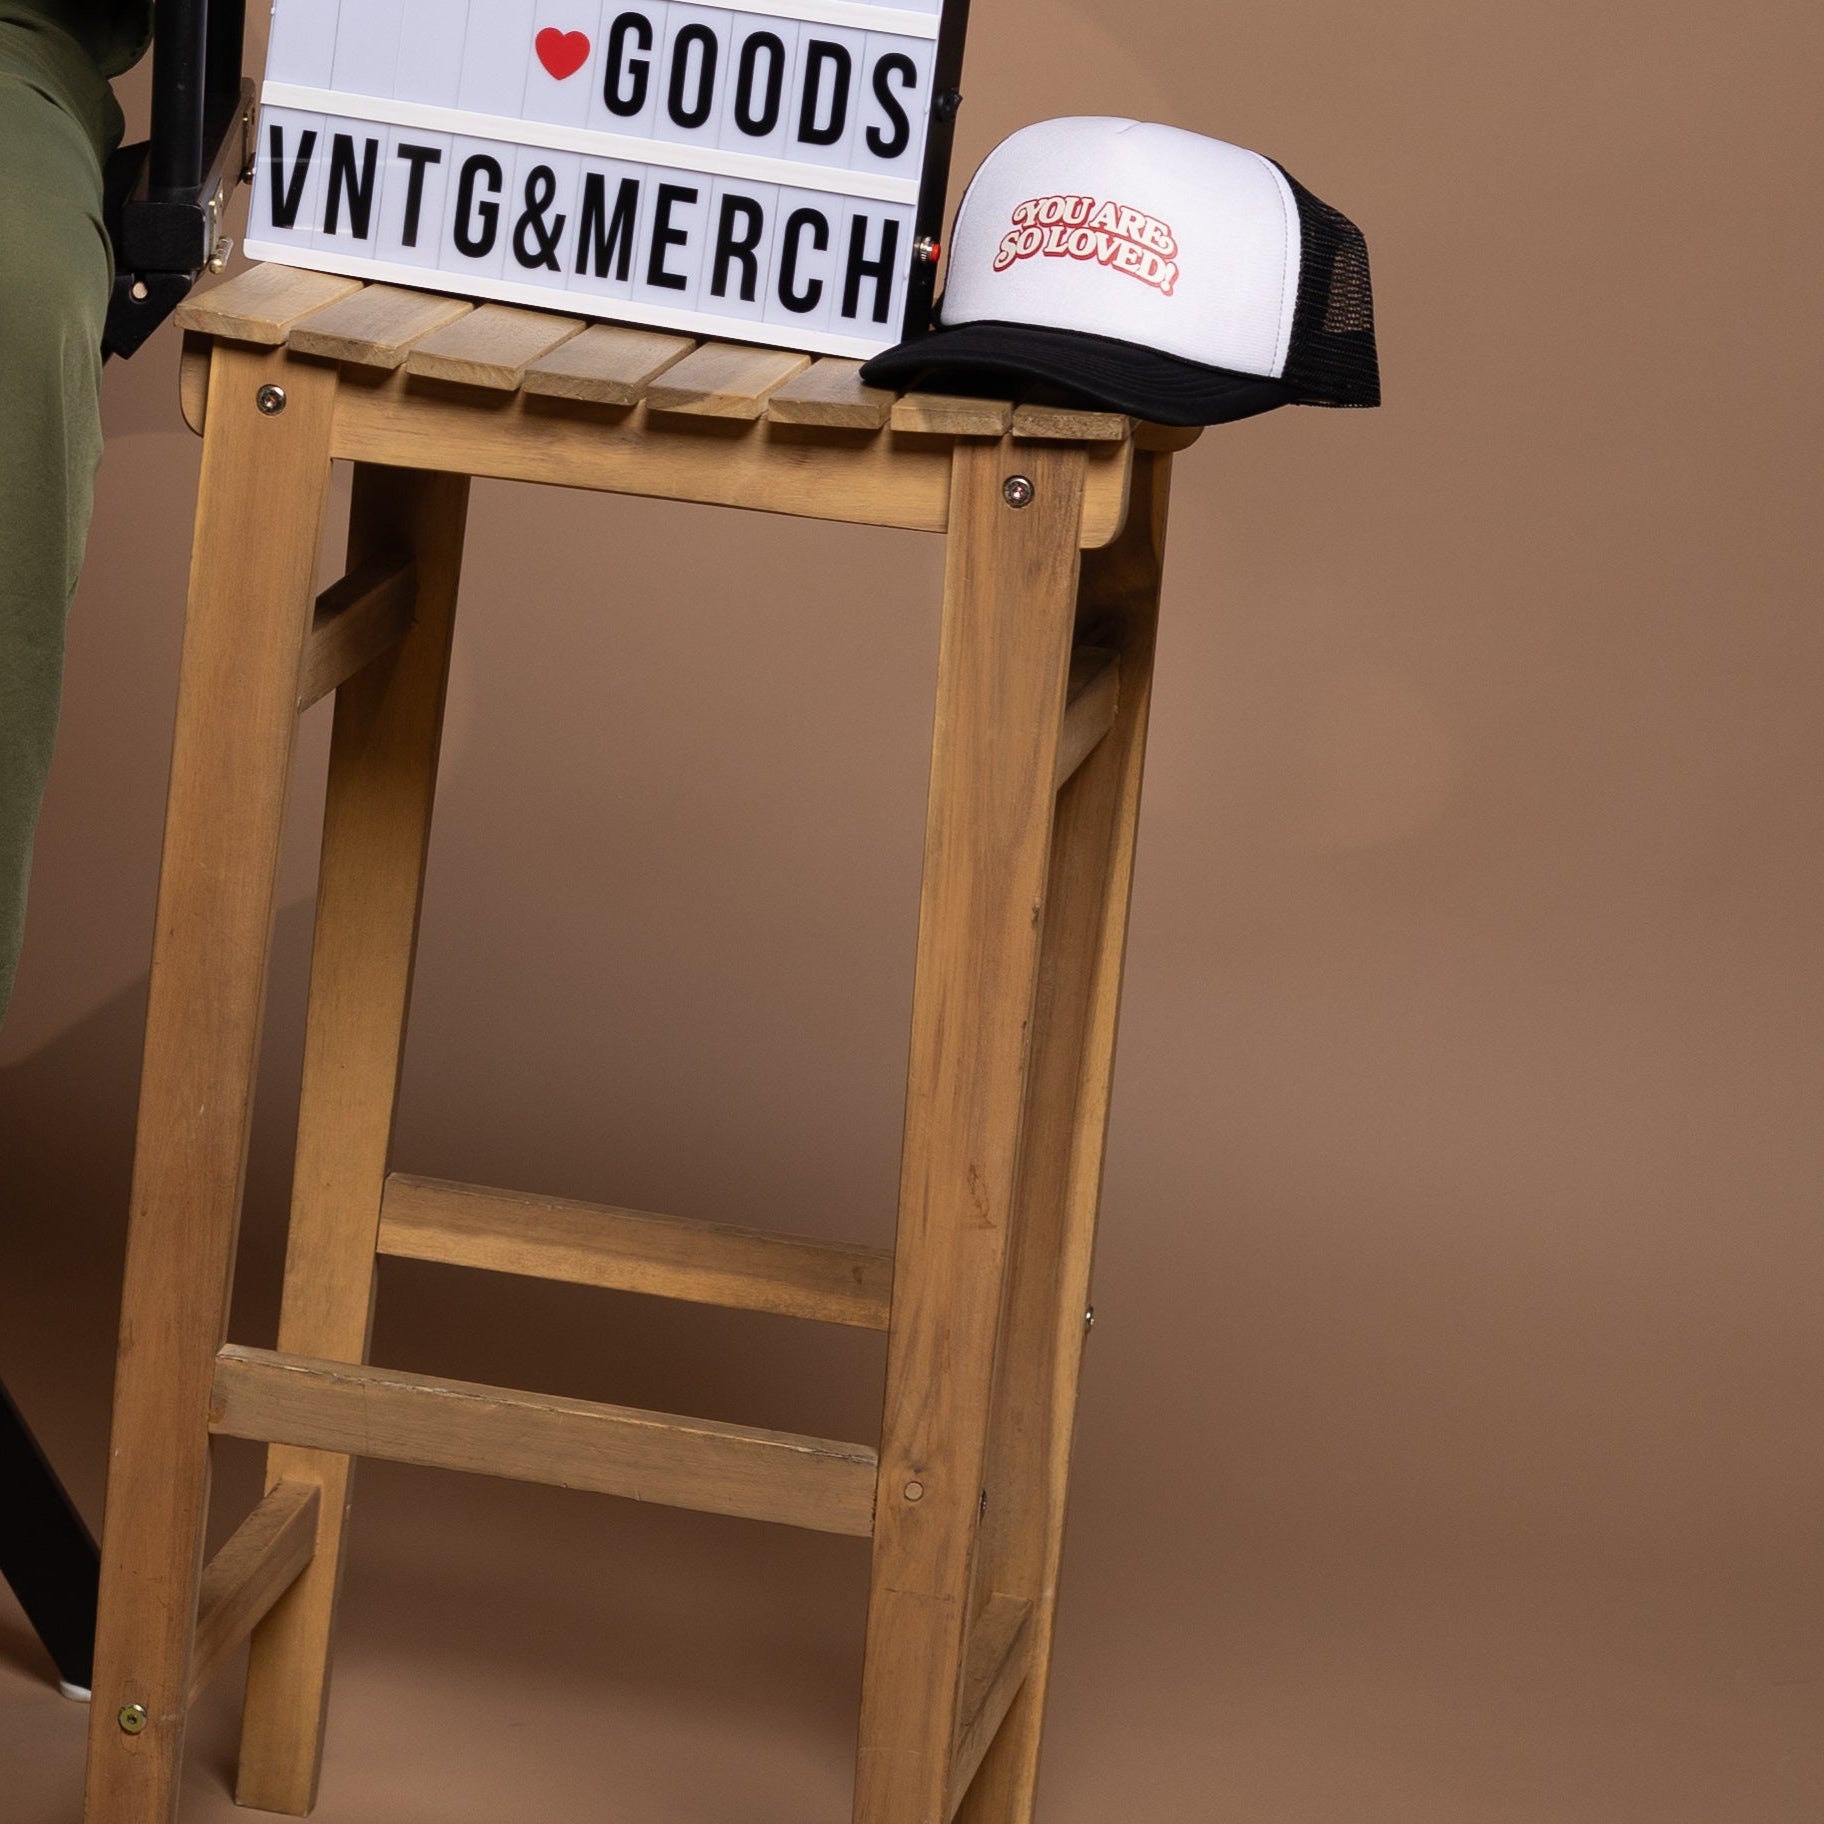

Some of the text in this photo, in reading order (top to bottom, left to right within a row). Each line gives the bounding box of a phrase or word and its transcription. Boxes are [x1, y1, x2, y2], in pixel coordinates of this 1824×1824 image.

[603, 12, 917, 159] GOODS
[269, 125, 900, 325] VNTG&MERCH
[993, 226, 1179, 296] SO LOVED!
[1012, 196, 1177, 259] YOU ARE
